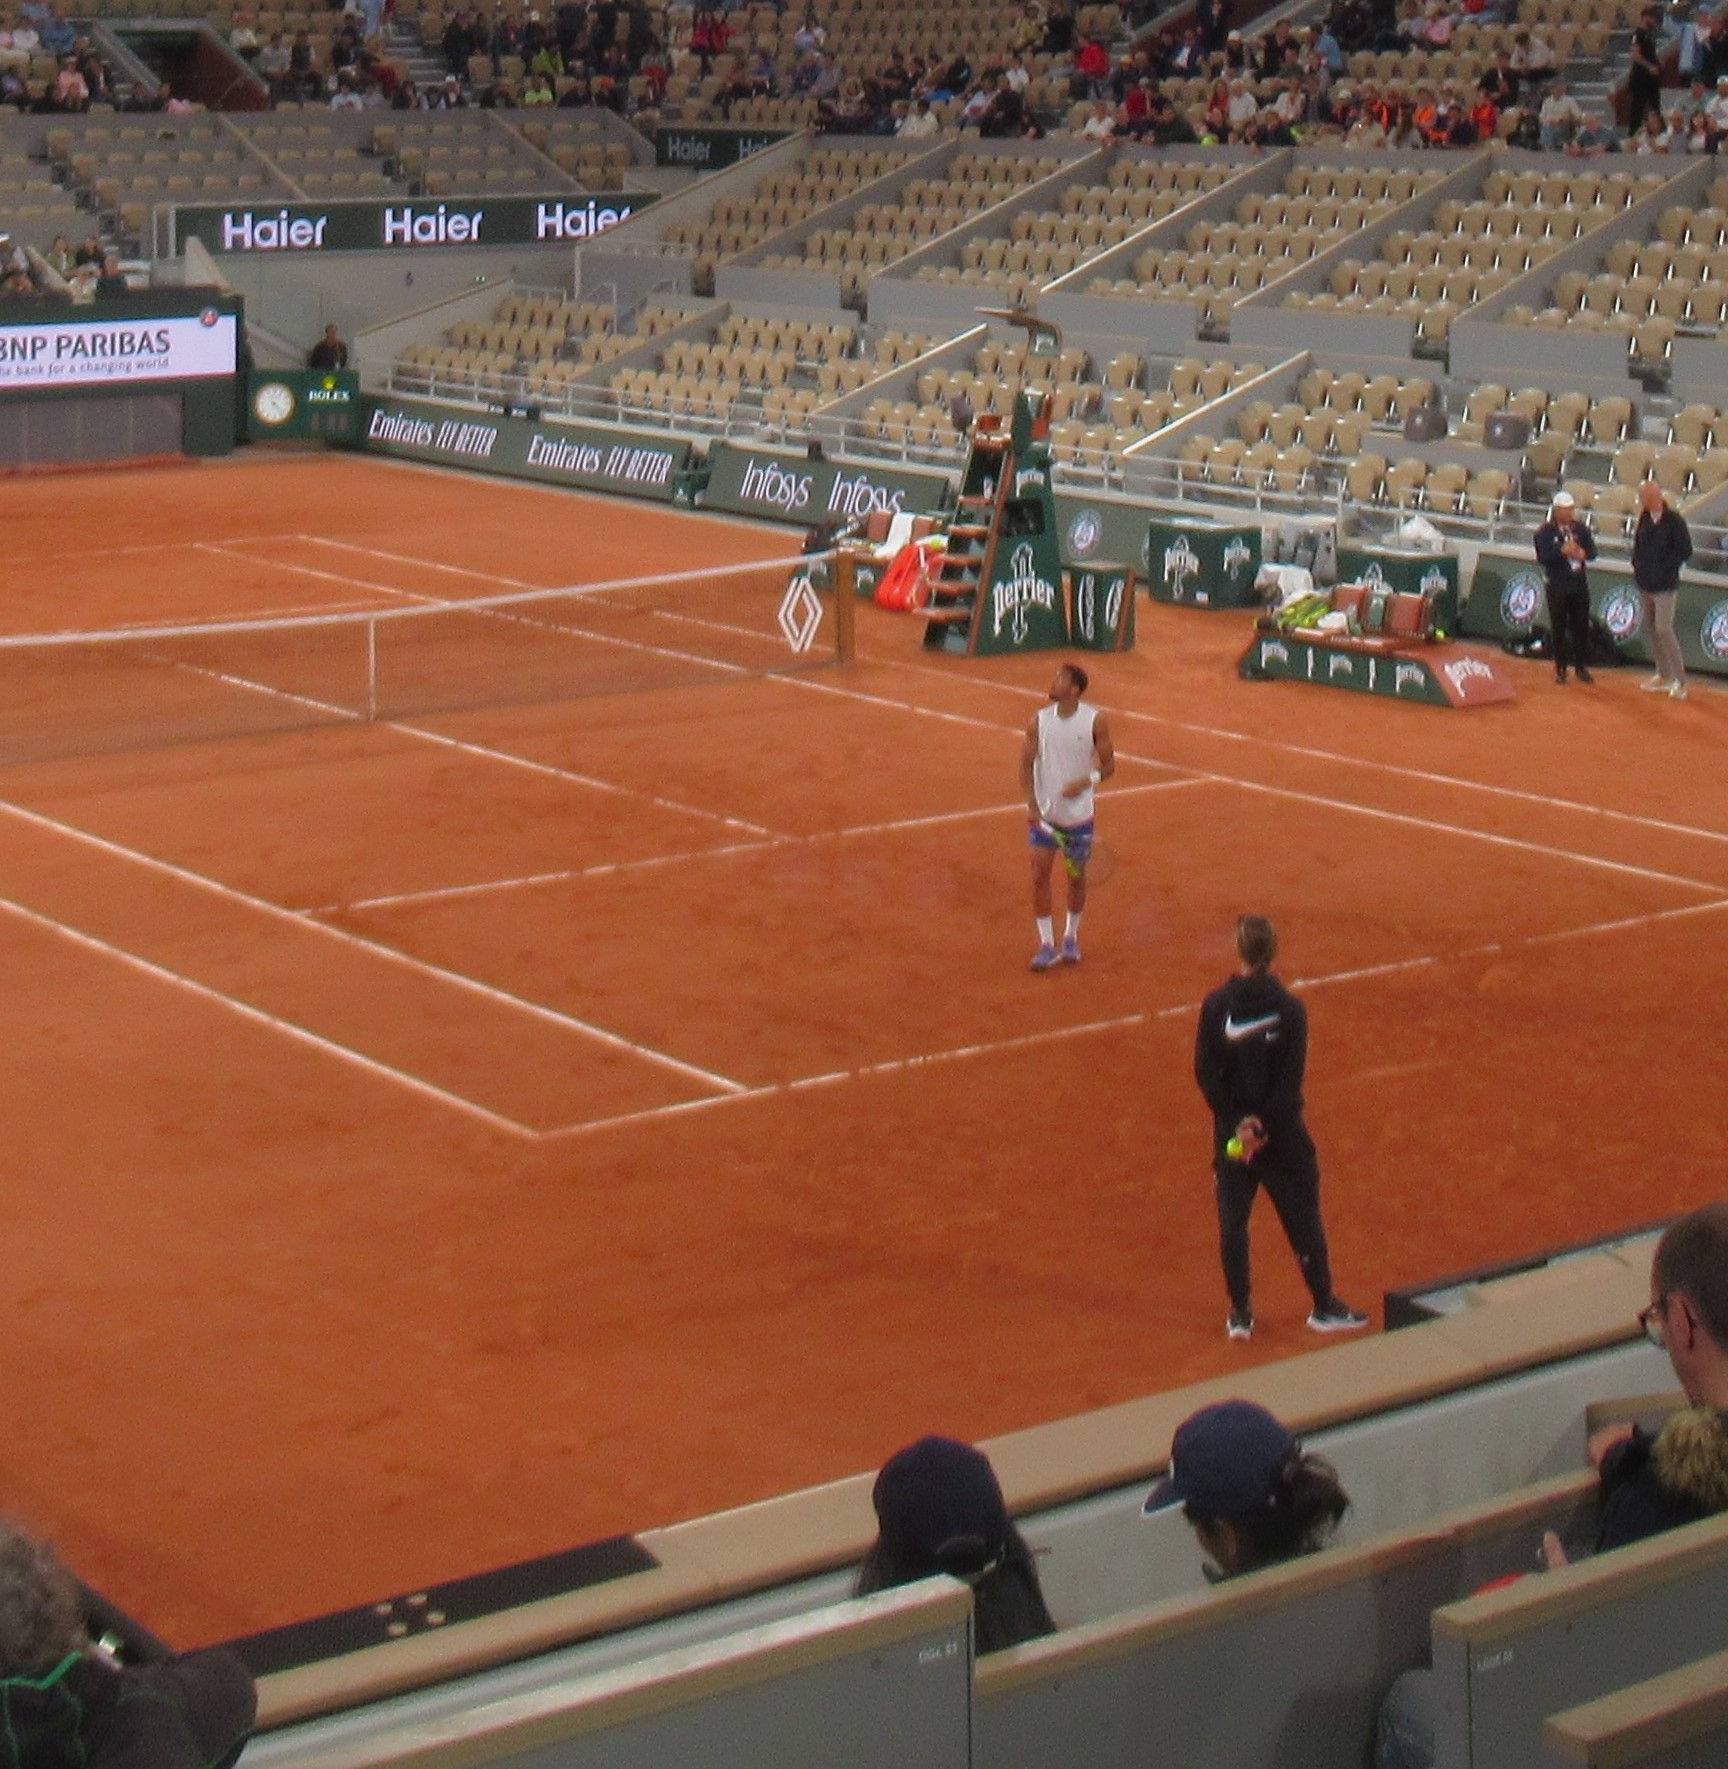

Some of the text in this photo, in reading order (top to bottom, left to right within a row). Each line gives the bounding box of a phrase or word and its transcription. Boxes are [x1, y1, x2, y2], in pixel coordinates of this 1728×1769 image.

[668, 135, 712, 160] Haier
[223, 209, 328, 250] Haier
[384, 204, 485, 245] Haier
[56, 329, 171, 359] PARIBAS
[16, 363, 44, 376] bank
[48, 362, 65, 378] for
[80, 361, 132, 375] changing
[136, 357, 169, 370] world
[308, 390, 350, 402] ROLEX
[369, 408, 434, 445] Emirates
[435, 419, 455, 449] FLY
[455, 422, 498, 456] BETTER
[526, 434, 603, 472] Emirates
[603, 445, 625, 476] FLY
[625, 450, 674, 484] BETTER
[740, 458, 814, 512] Infosys
